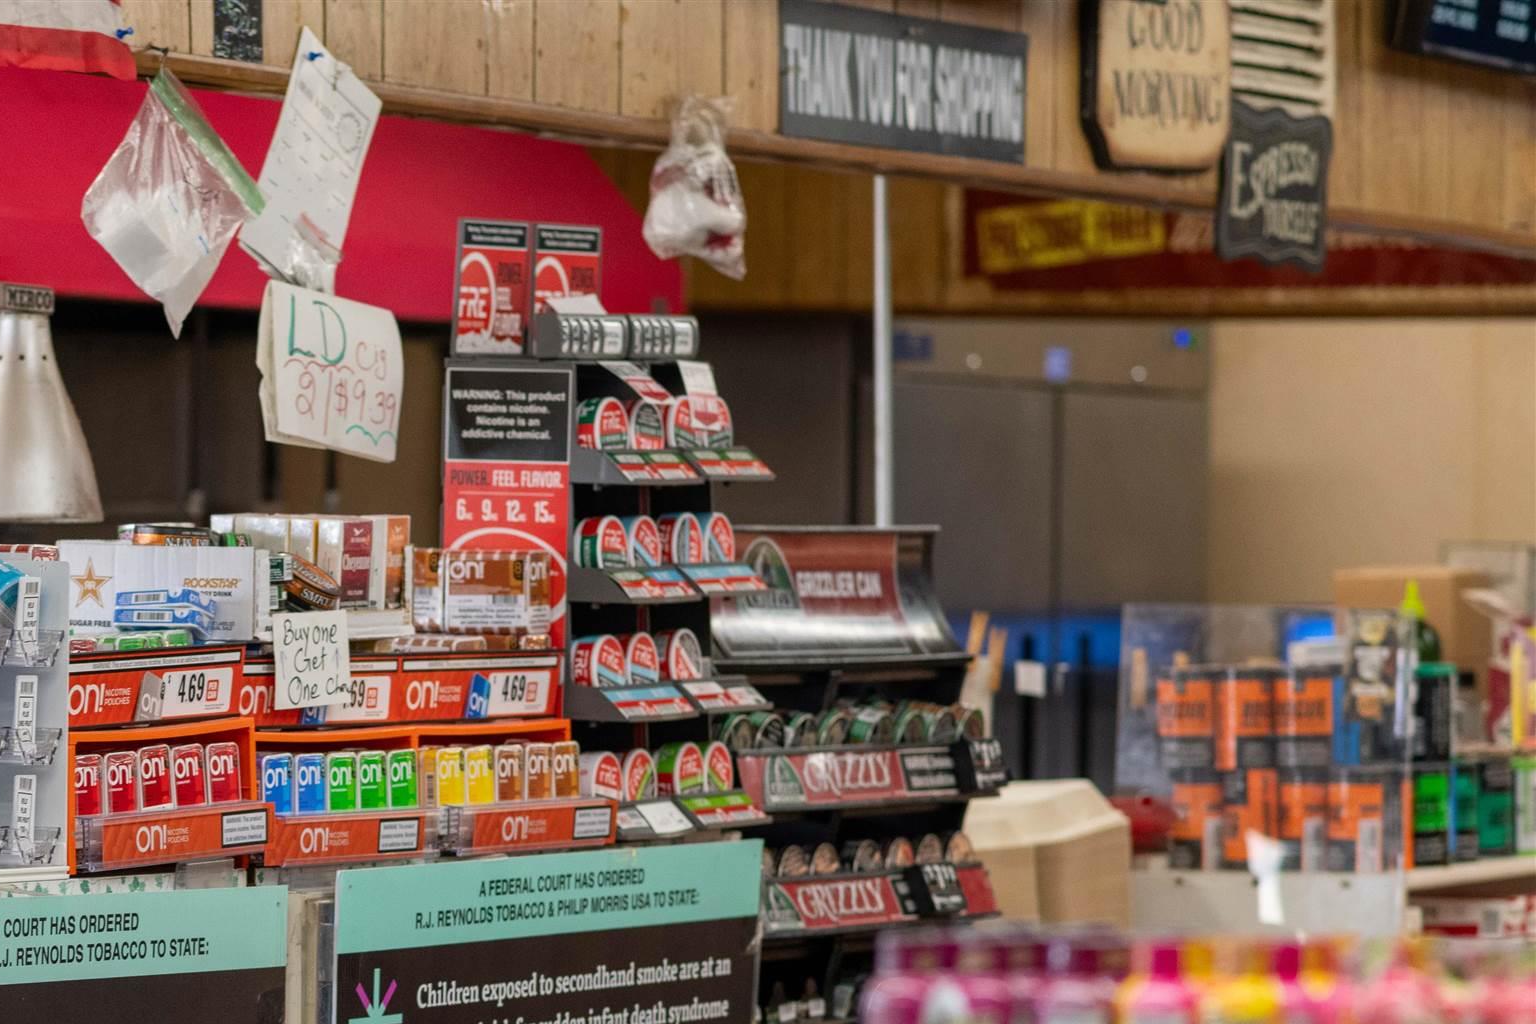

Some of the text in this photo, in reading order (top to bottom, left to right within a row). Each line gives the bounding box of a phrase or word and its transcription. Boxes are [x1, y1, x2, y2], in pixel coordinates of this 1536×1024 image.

[784, 23, 1023, 143] THANK YOU FOR SHOPPING
[288, 293, 347, 365] LD
[453, 390, 566, 402] WARNING: This product
[467, 404, 549, 414] contains nicotine.
[462, 429, 550, 440] addictive chemical.
[476, 416, 515, 426] Nicotine
[518, 418, 526, 426] is
[183, 577, 239, 589] ROCKSTAR
[283, 619, 338, 654] Buy one
[294, 649, 328, 674] Get
[288, 675, 319, 705] One
[209, 754, 234, 776] on!
[803, 751, 894, 794] GRIZZLY
[479, 869, 644, 898] A FEDERAL COURT HAS ORDERED
[416, 889, 698, 929] R.J. REYNOLDS TOBACCO & PHILIP MORRIS USA TO STATE:
[796, 878, 884, 920] GRIZZLY
[4, 918, 47, 938] COURT
[50, 916, 76, 935] HAS
[80, 913, 139, 934] ORDERED
[17, 944, 84, 966] REYNOLDS
[88, 941, 147, 962] TOBACCO
[151, 940, 166, 958] TO
[170, 938, 208, 957] STATE:
[417, 958, 731, 1008] Children exposed to secondhand smoke are at an
